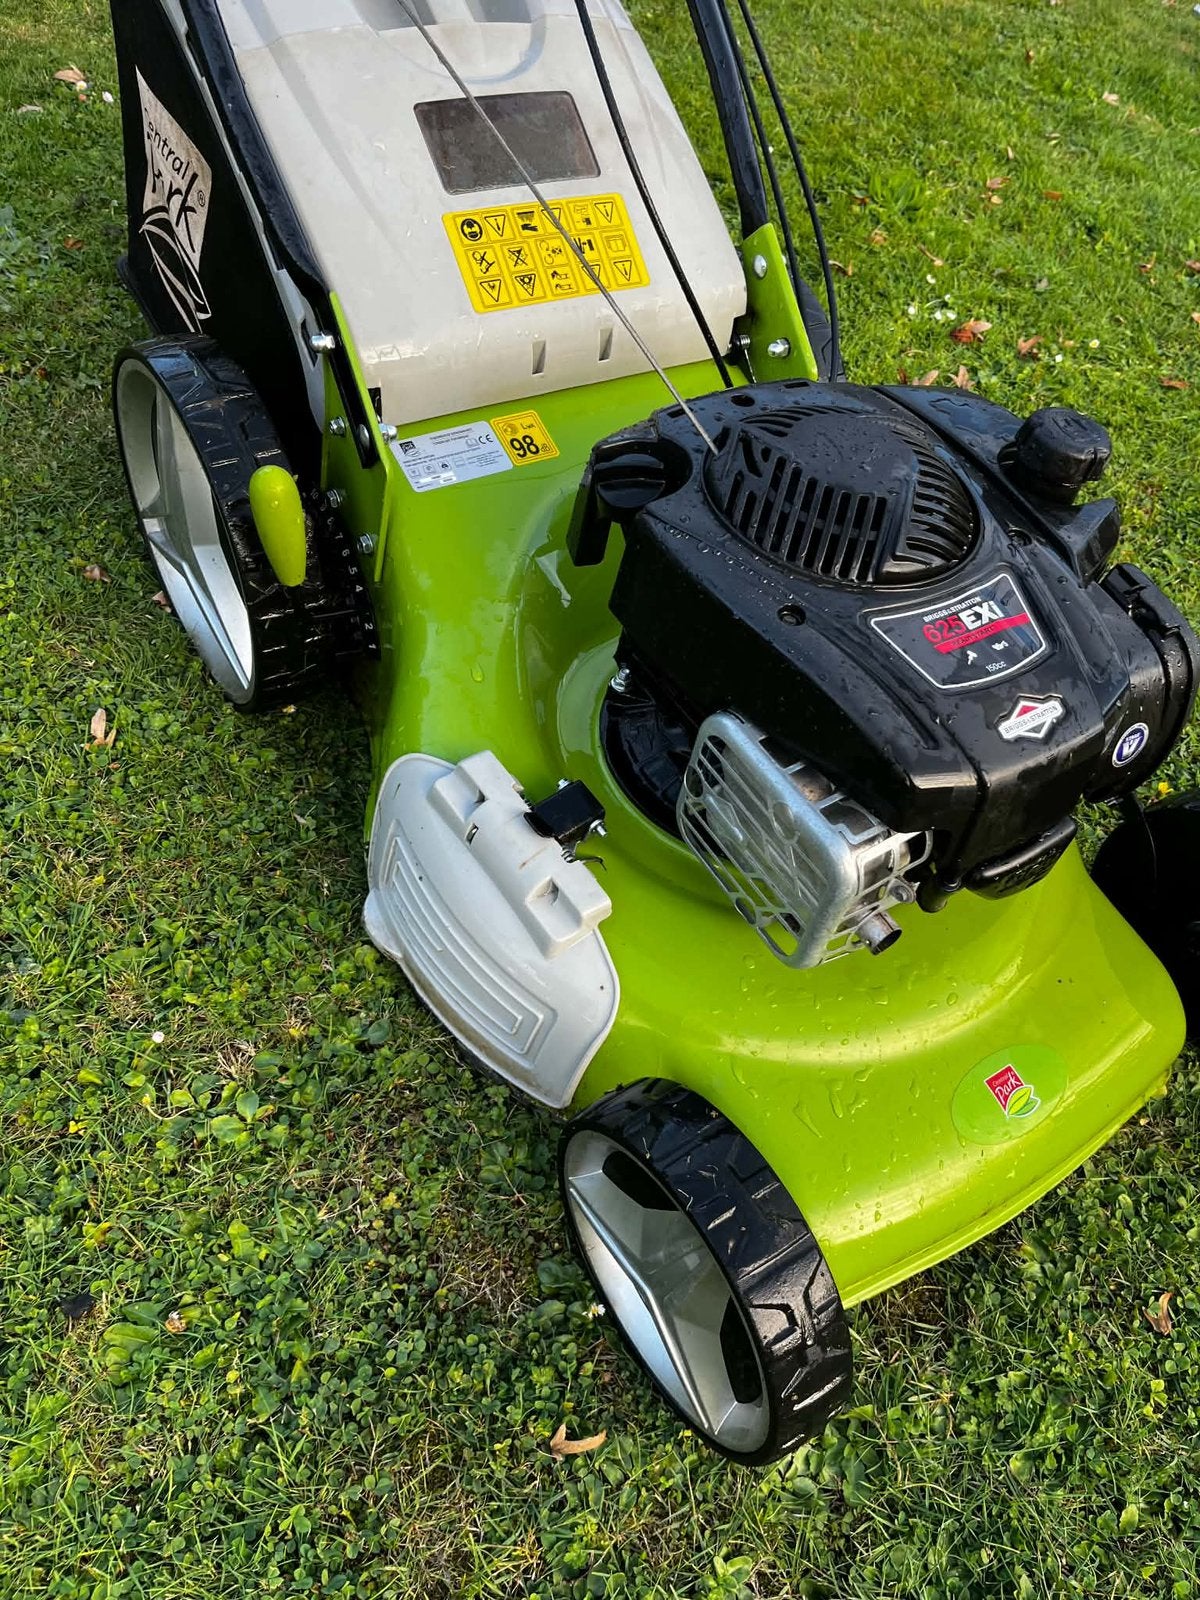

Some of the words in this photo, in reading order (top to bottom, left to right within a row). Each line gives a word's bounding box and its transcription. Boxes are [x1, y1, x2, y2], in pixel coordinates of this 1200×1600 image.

[145, 109, 190, 180] entral
[510, 435, 540, 458] 98
[348, 566, 358, 575] 5
[355, 584, 364, 593] 4
[364, 622, 374, 631] 2
[985, 660, 1008, 674] 150cc
[994, 1072, 1022, 1105] Park
